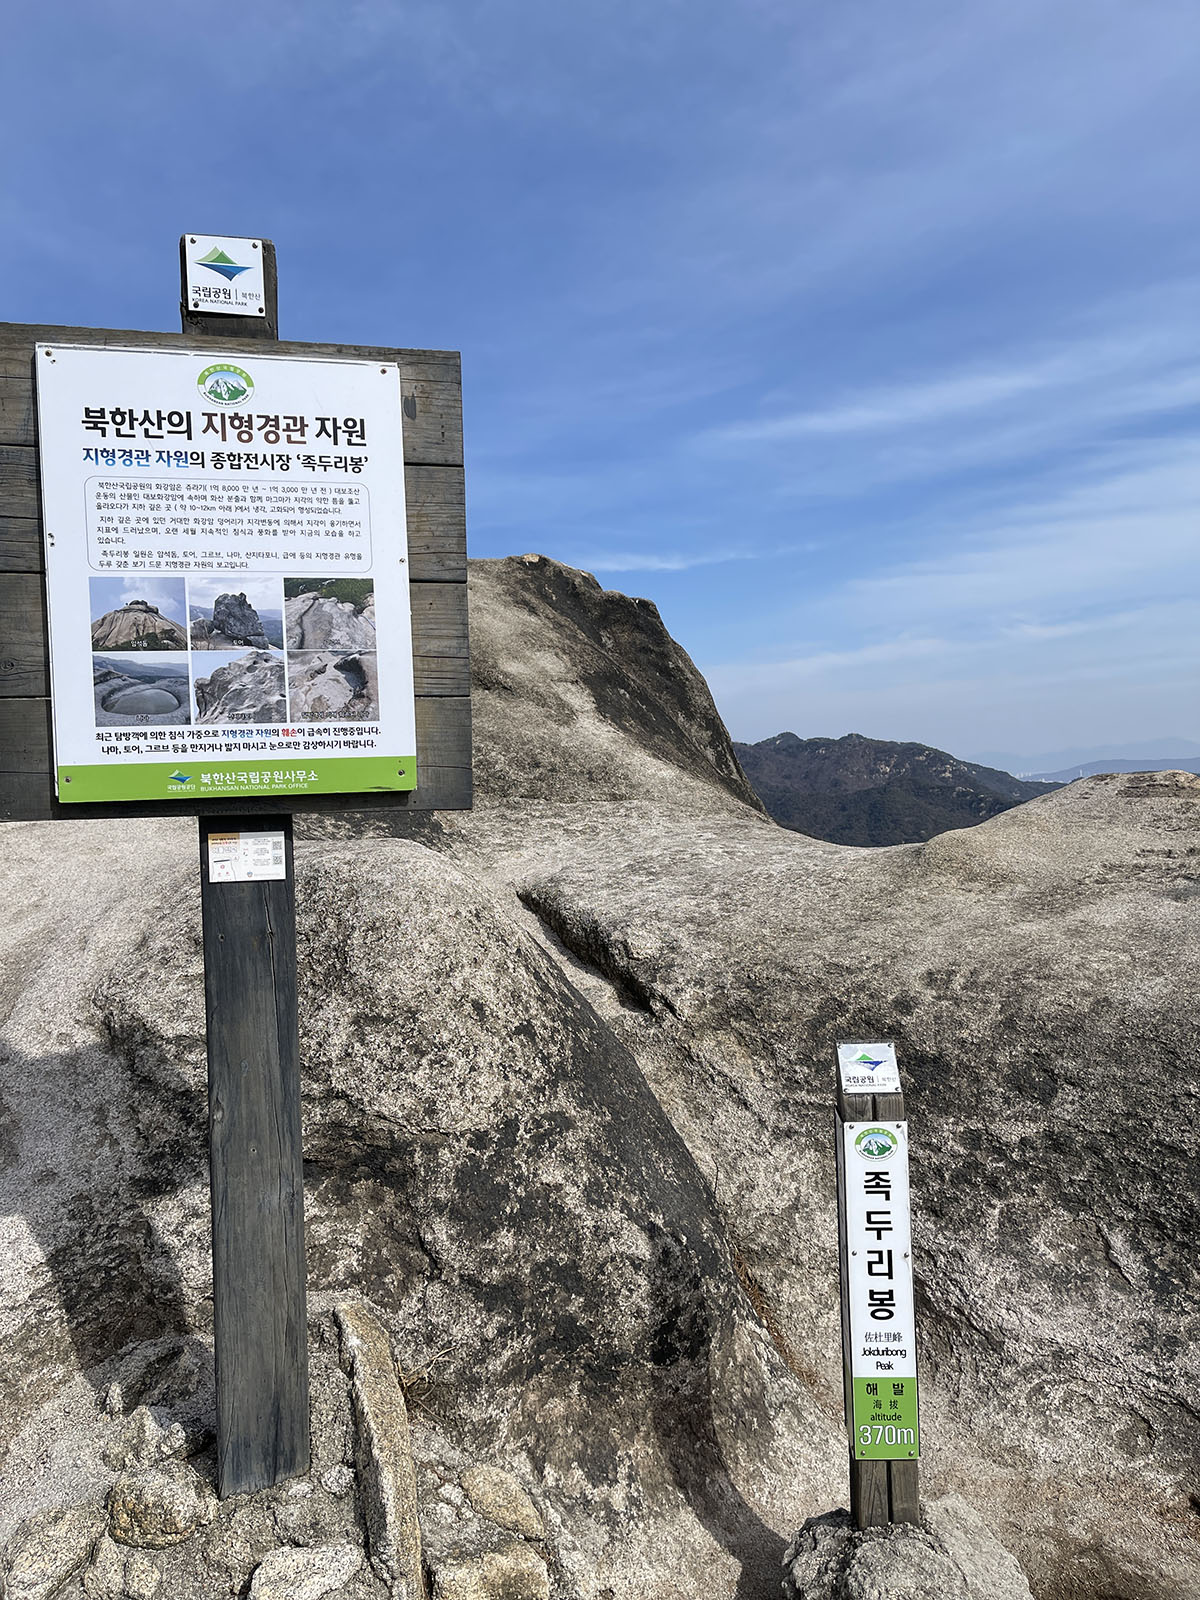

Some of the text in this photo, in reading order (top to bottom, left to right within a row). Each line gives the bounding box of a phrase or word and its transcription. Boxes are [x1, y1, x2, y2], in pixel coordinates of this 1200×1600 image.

[192, 285, 231, 300] 국립공원
[81, 406, 367, 447] 북한산의 지형경관 자원
[82, 447, 151, 467] 지형경관
[155, 449, 205, 469] 자원의
[210, 451, 292, 472] 종합전시장
[96, 727, 381, 741] 최근 탐방객에 의한 침식 가중으로 지형경관 자원의 훼손이 급속히 진행중입니다.
[102, 746, 121, 754] 나마,
[124, 745, 143, 754] 토어,
[172, 744, 188, 753] 등을
[190, 743, 222, 752] 만지거나
[243, 742, 267, 751] 마시고
[269, 741, 300, 750] 눈으로만
[303, 740, 341, 750] 감상하시기
[343, 740, 376, 748] 바랍니다.
[200, 770, 319, 785] 북한산국립공원사무소
[864, 1171, 896, 1320] 족두리봉
[861, 1347, 906, 1358] Jokduribong
[876, 1361, 894, 1370] Peak
[870, 1413, 902, 1421] altitude
[859, 1424, 915, 1446] 370m
